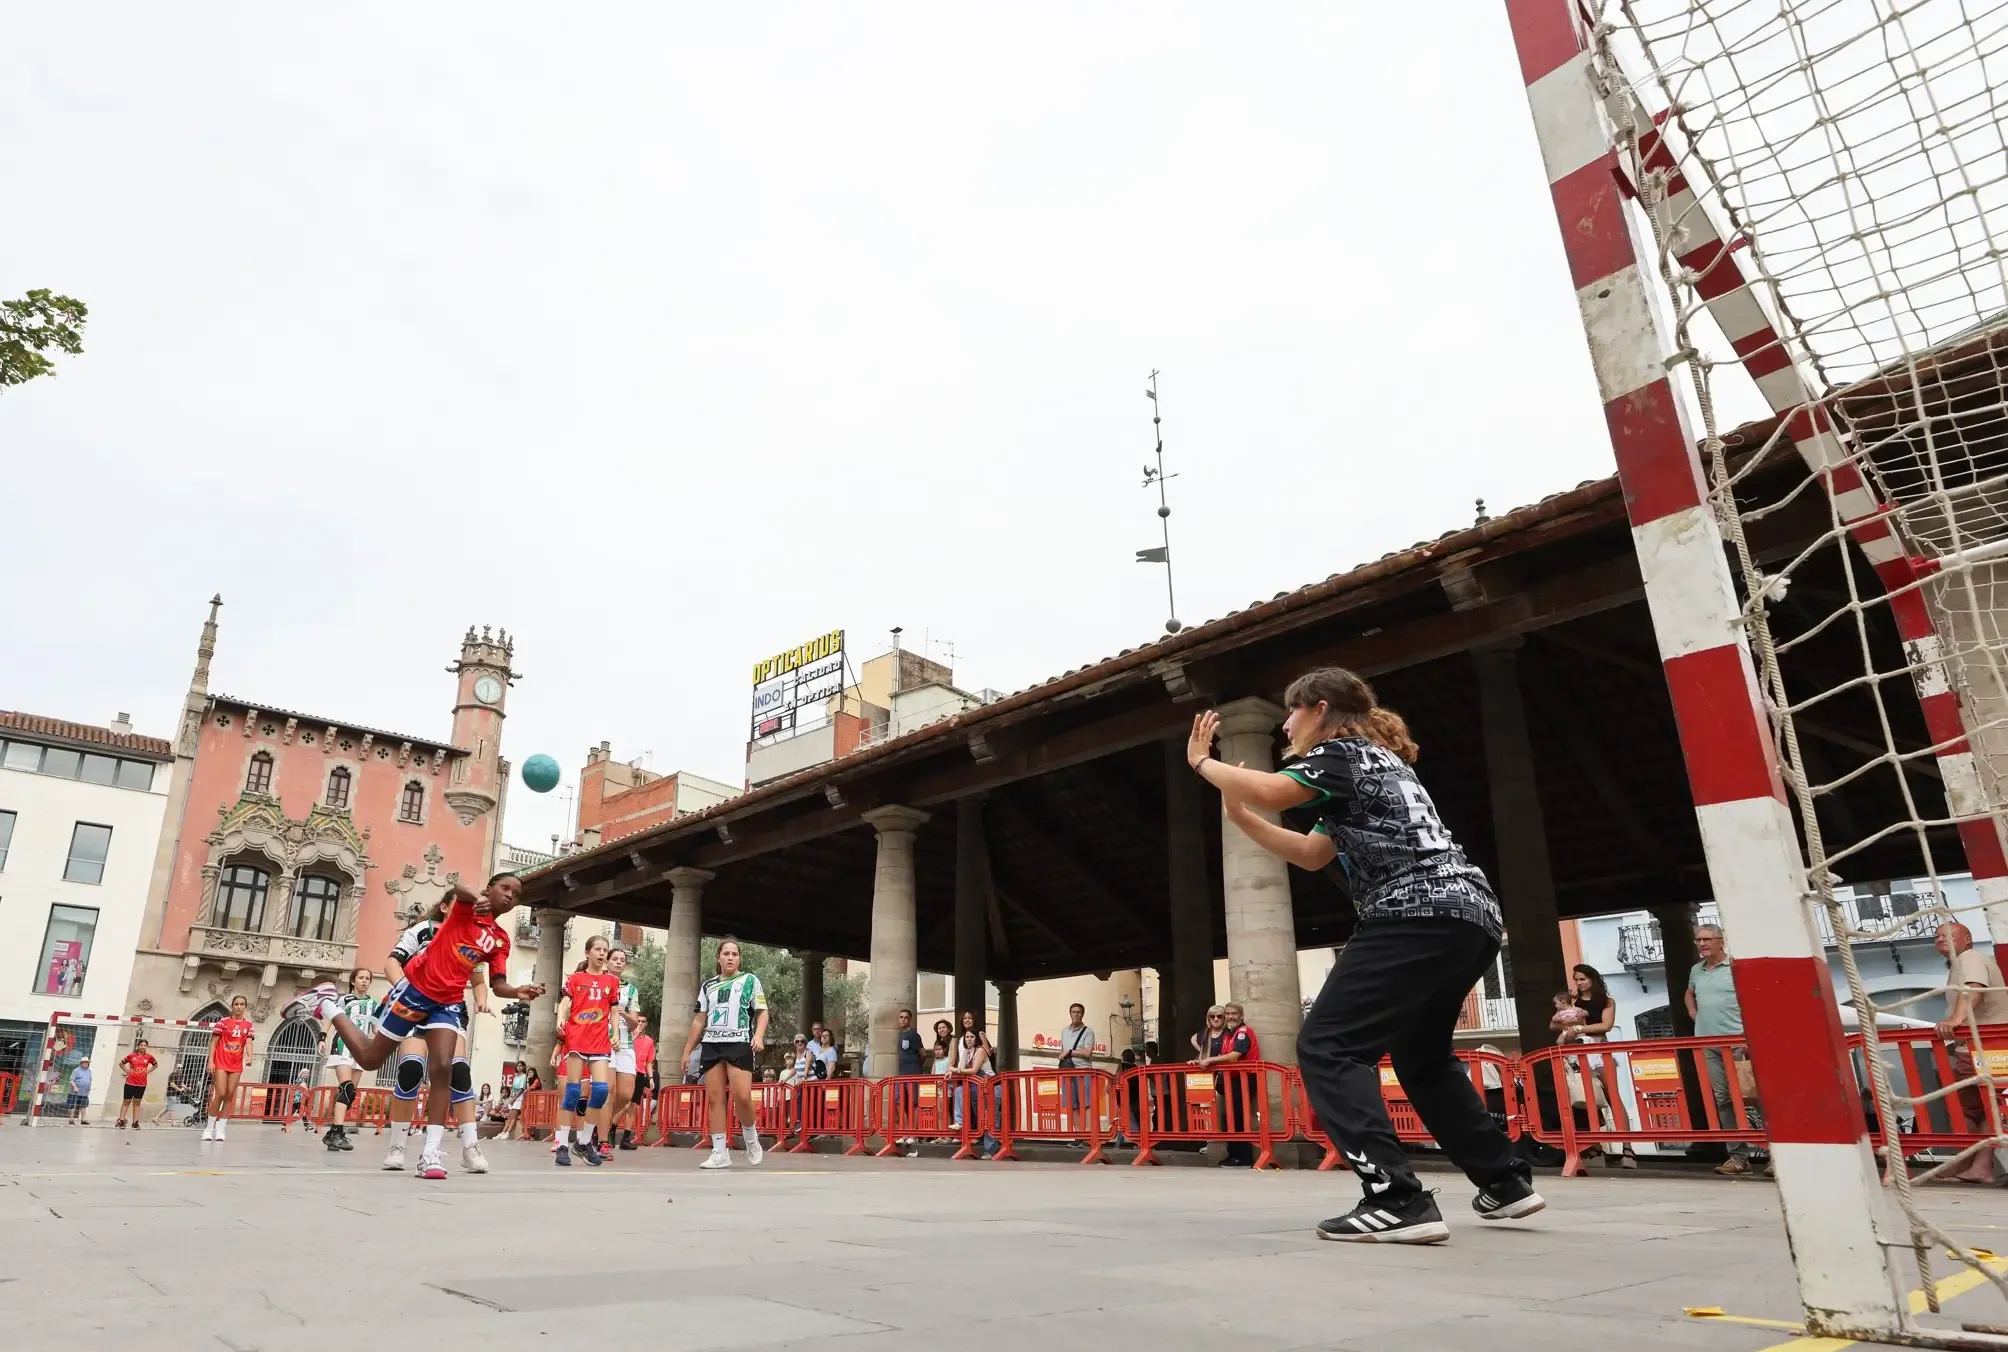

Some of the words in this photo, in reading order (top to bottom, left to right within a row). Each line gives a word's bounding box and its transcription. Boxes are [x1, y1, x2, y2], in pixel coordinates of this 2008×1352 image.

[752, 629, 841, 685] OPTICARIUS
[793, 659, 842, 686] CALIDAD
[754, 689, 781, 709] INDO
[475, 929, 495, 953] 10
[588, 988, 602, 1000] 11
[231, 1029, 242, 1038] 21
